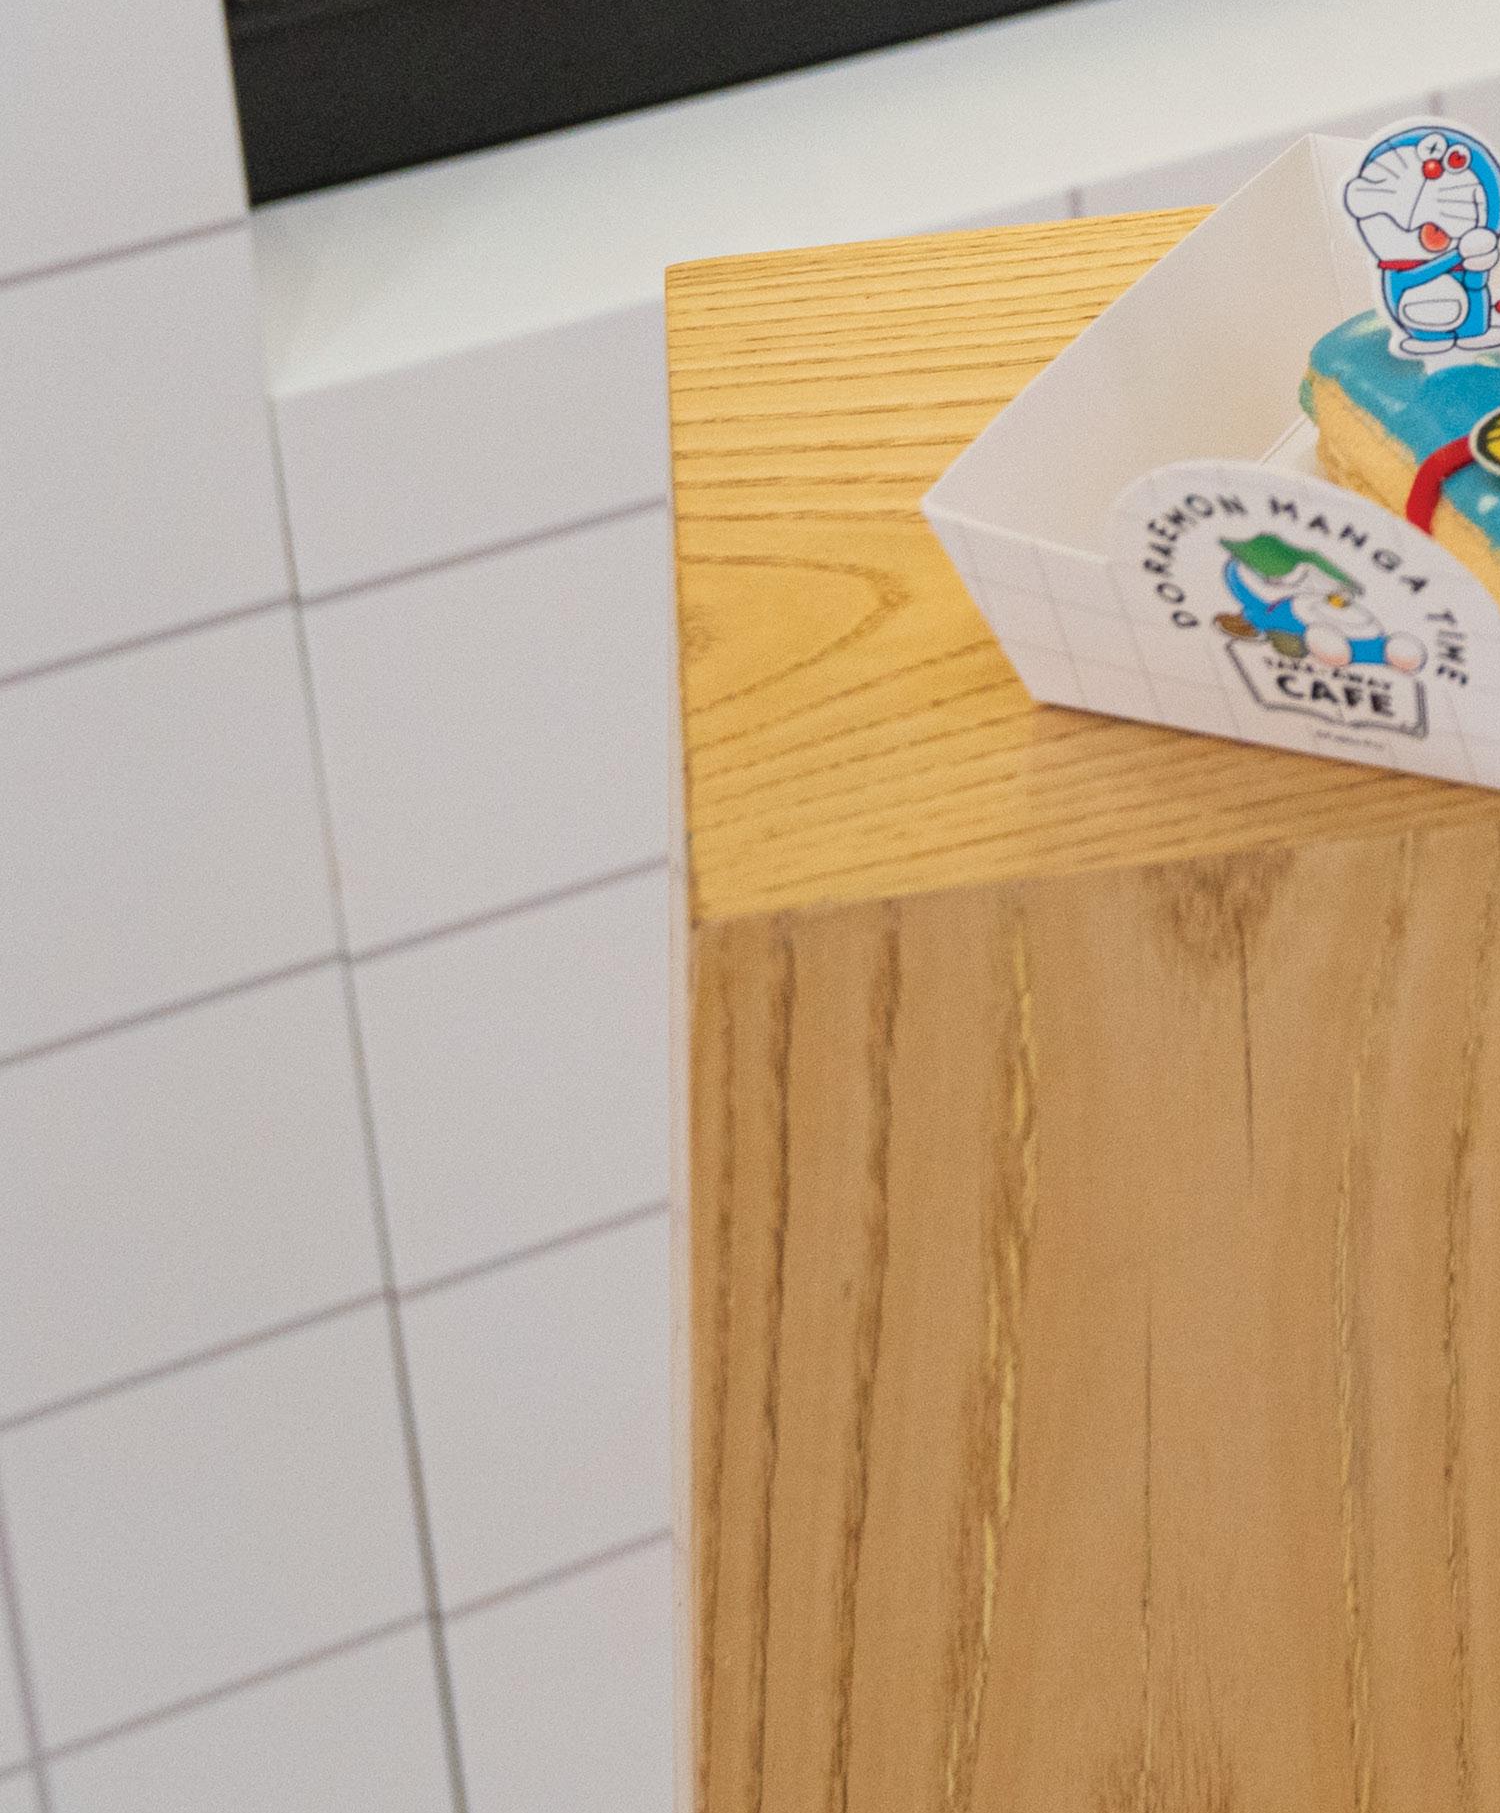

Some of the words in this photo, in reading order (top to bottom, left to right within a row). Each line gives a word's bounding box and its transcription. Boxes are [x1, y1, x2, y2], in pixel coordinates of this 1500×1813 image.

[1143, 493, 1248, 630] DORAEMON
[1268, 496, 1430, 596] MANGA
[1426, 607, 1469, 688] TIME
[1276, 674, 1395, 718] CAFE
